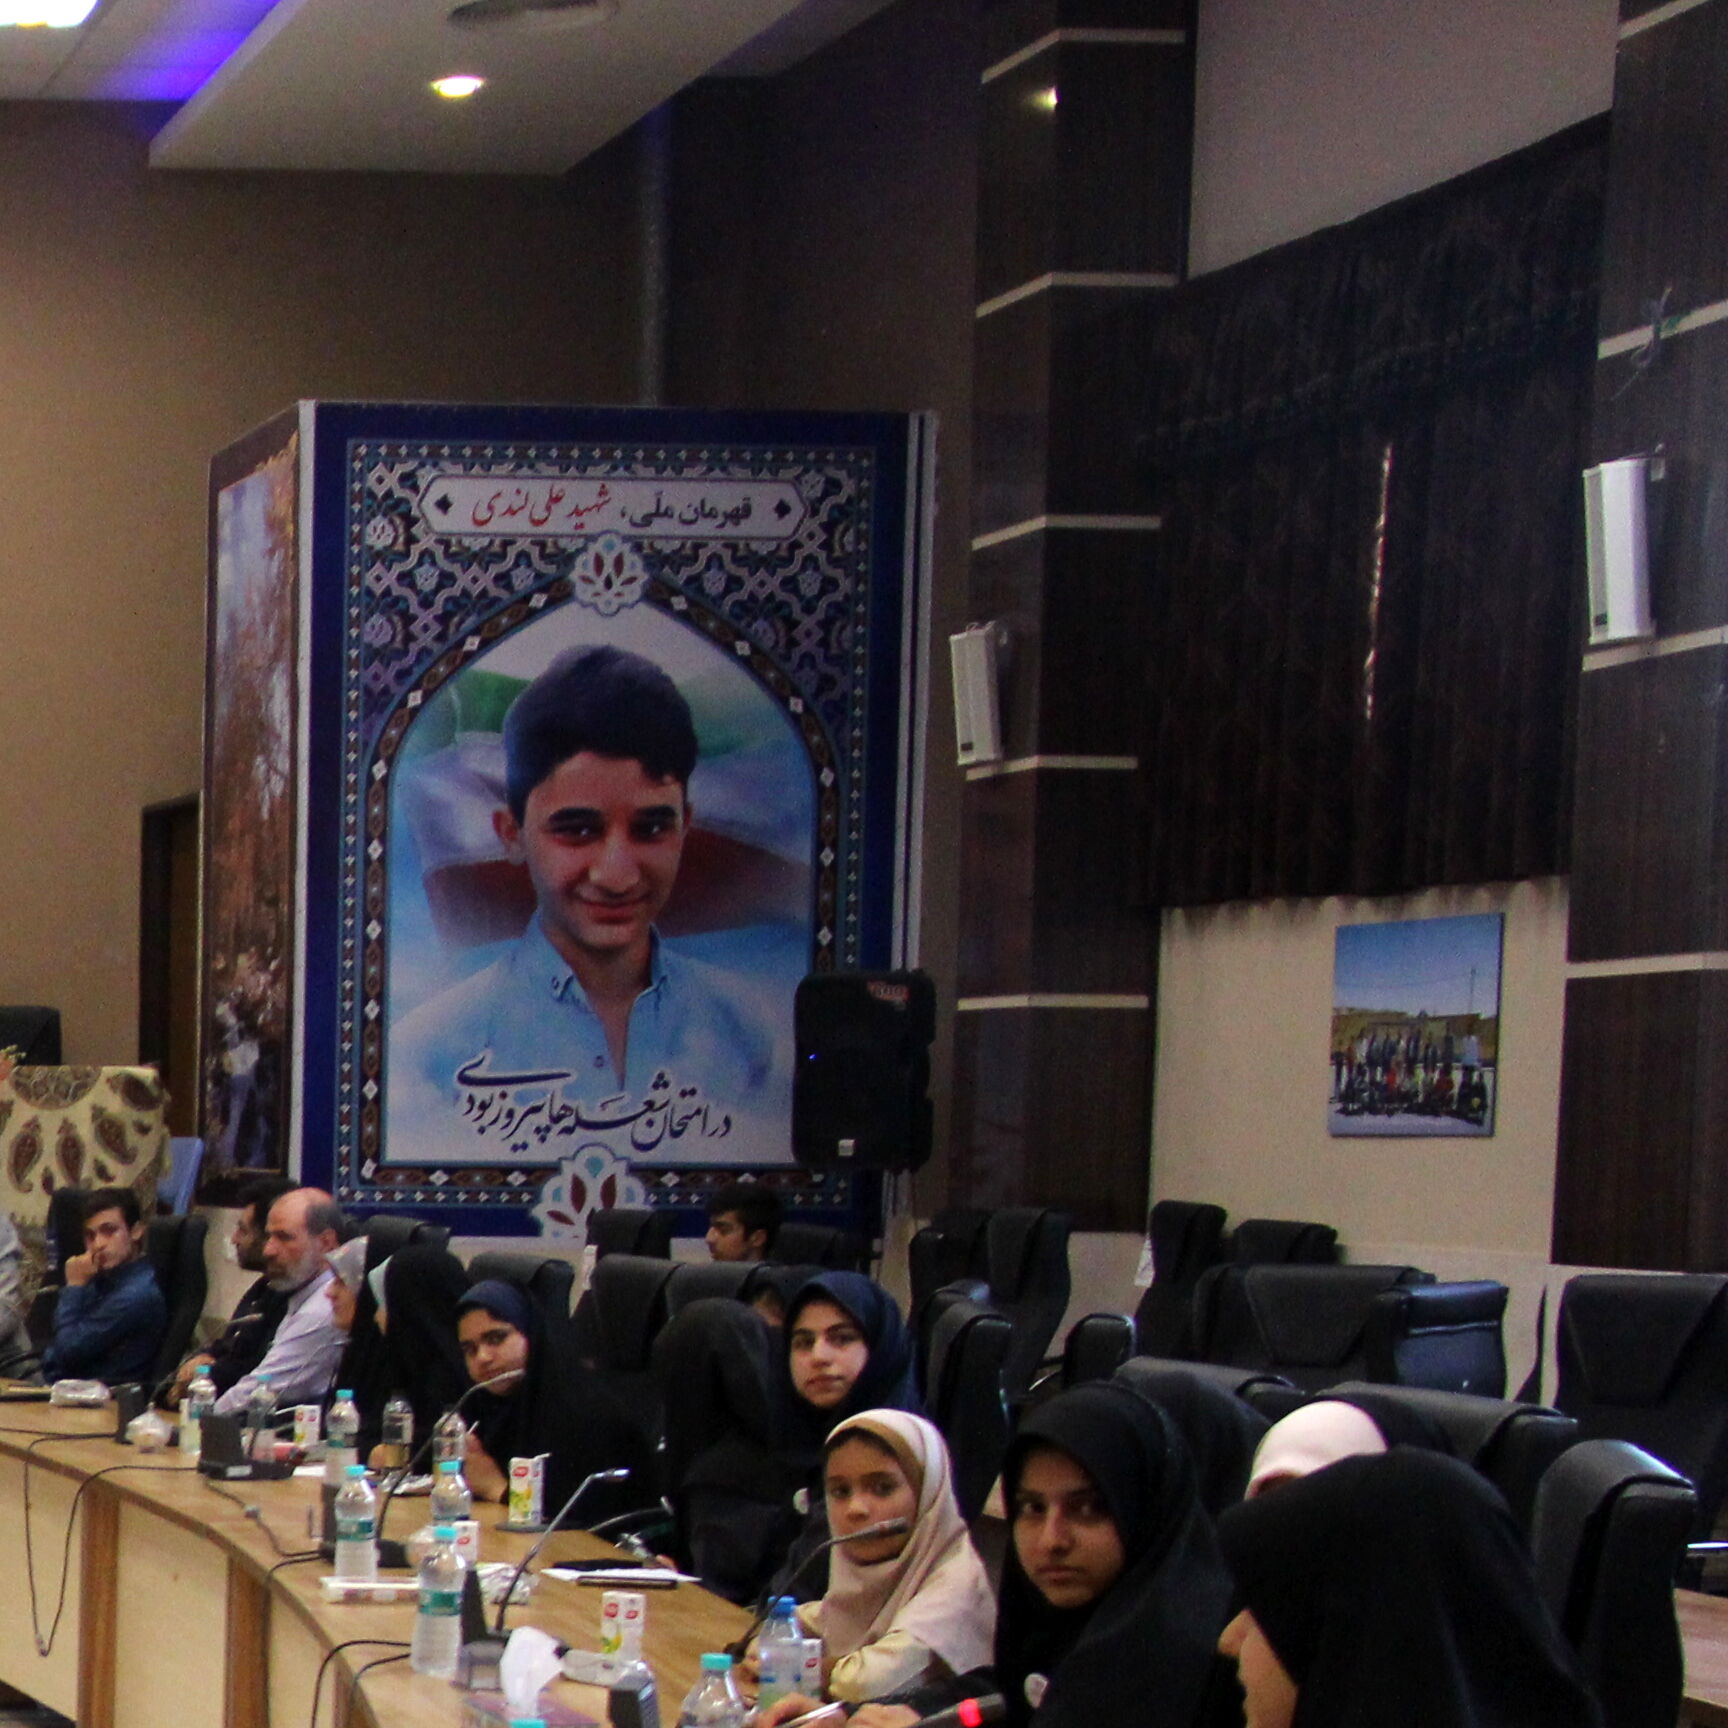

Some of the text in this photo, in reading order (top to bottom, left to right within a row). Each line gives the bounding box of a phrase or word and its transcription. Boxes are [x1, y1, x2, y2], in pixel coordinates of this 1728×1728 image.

[471, 488, 528, 528] لندی
[528, 484, 566, 527] علی
[567, 482, 612, 532] شهید
[678, 497, 753, 530] قهرمان
[486, 1088, 554, 1153] پیروز
[629, 1086, 710, 1153] امتحان
[710, 1114, 732, 1139] در
